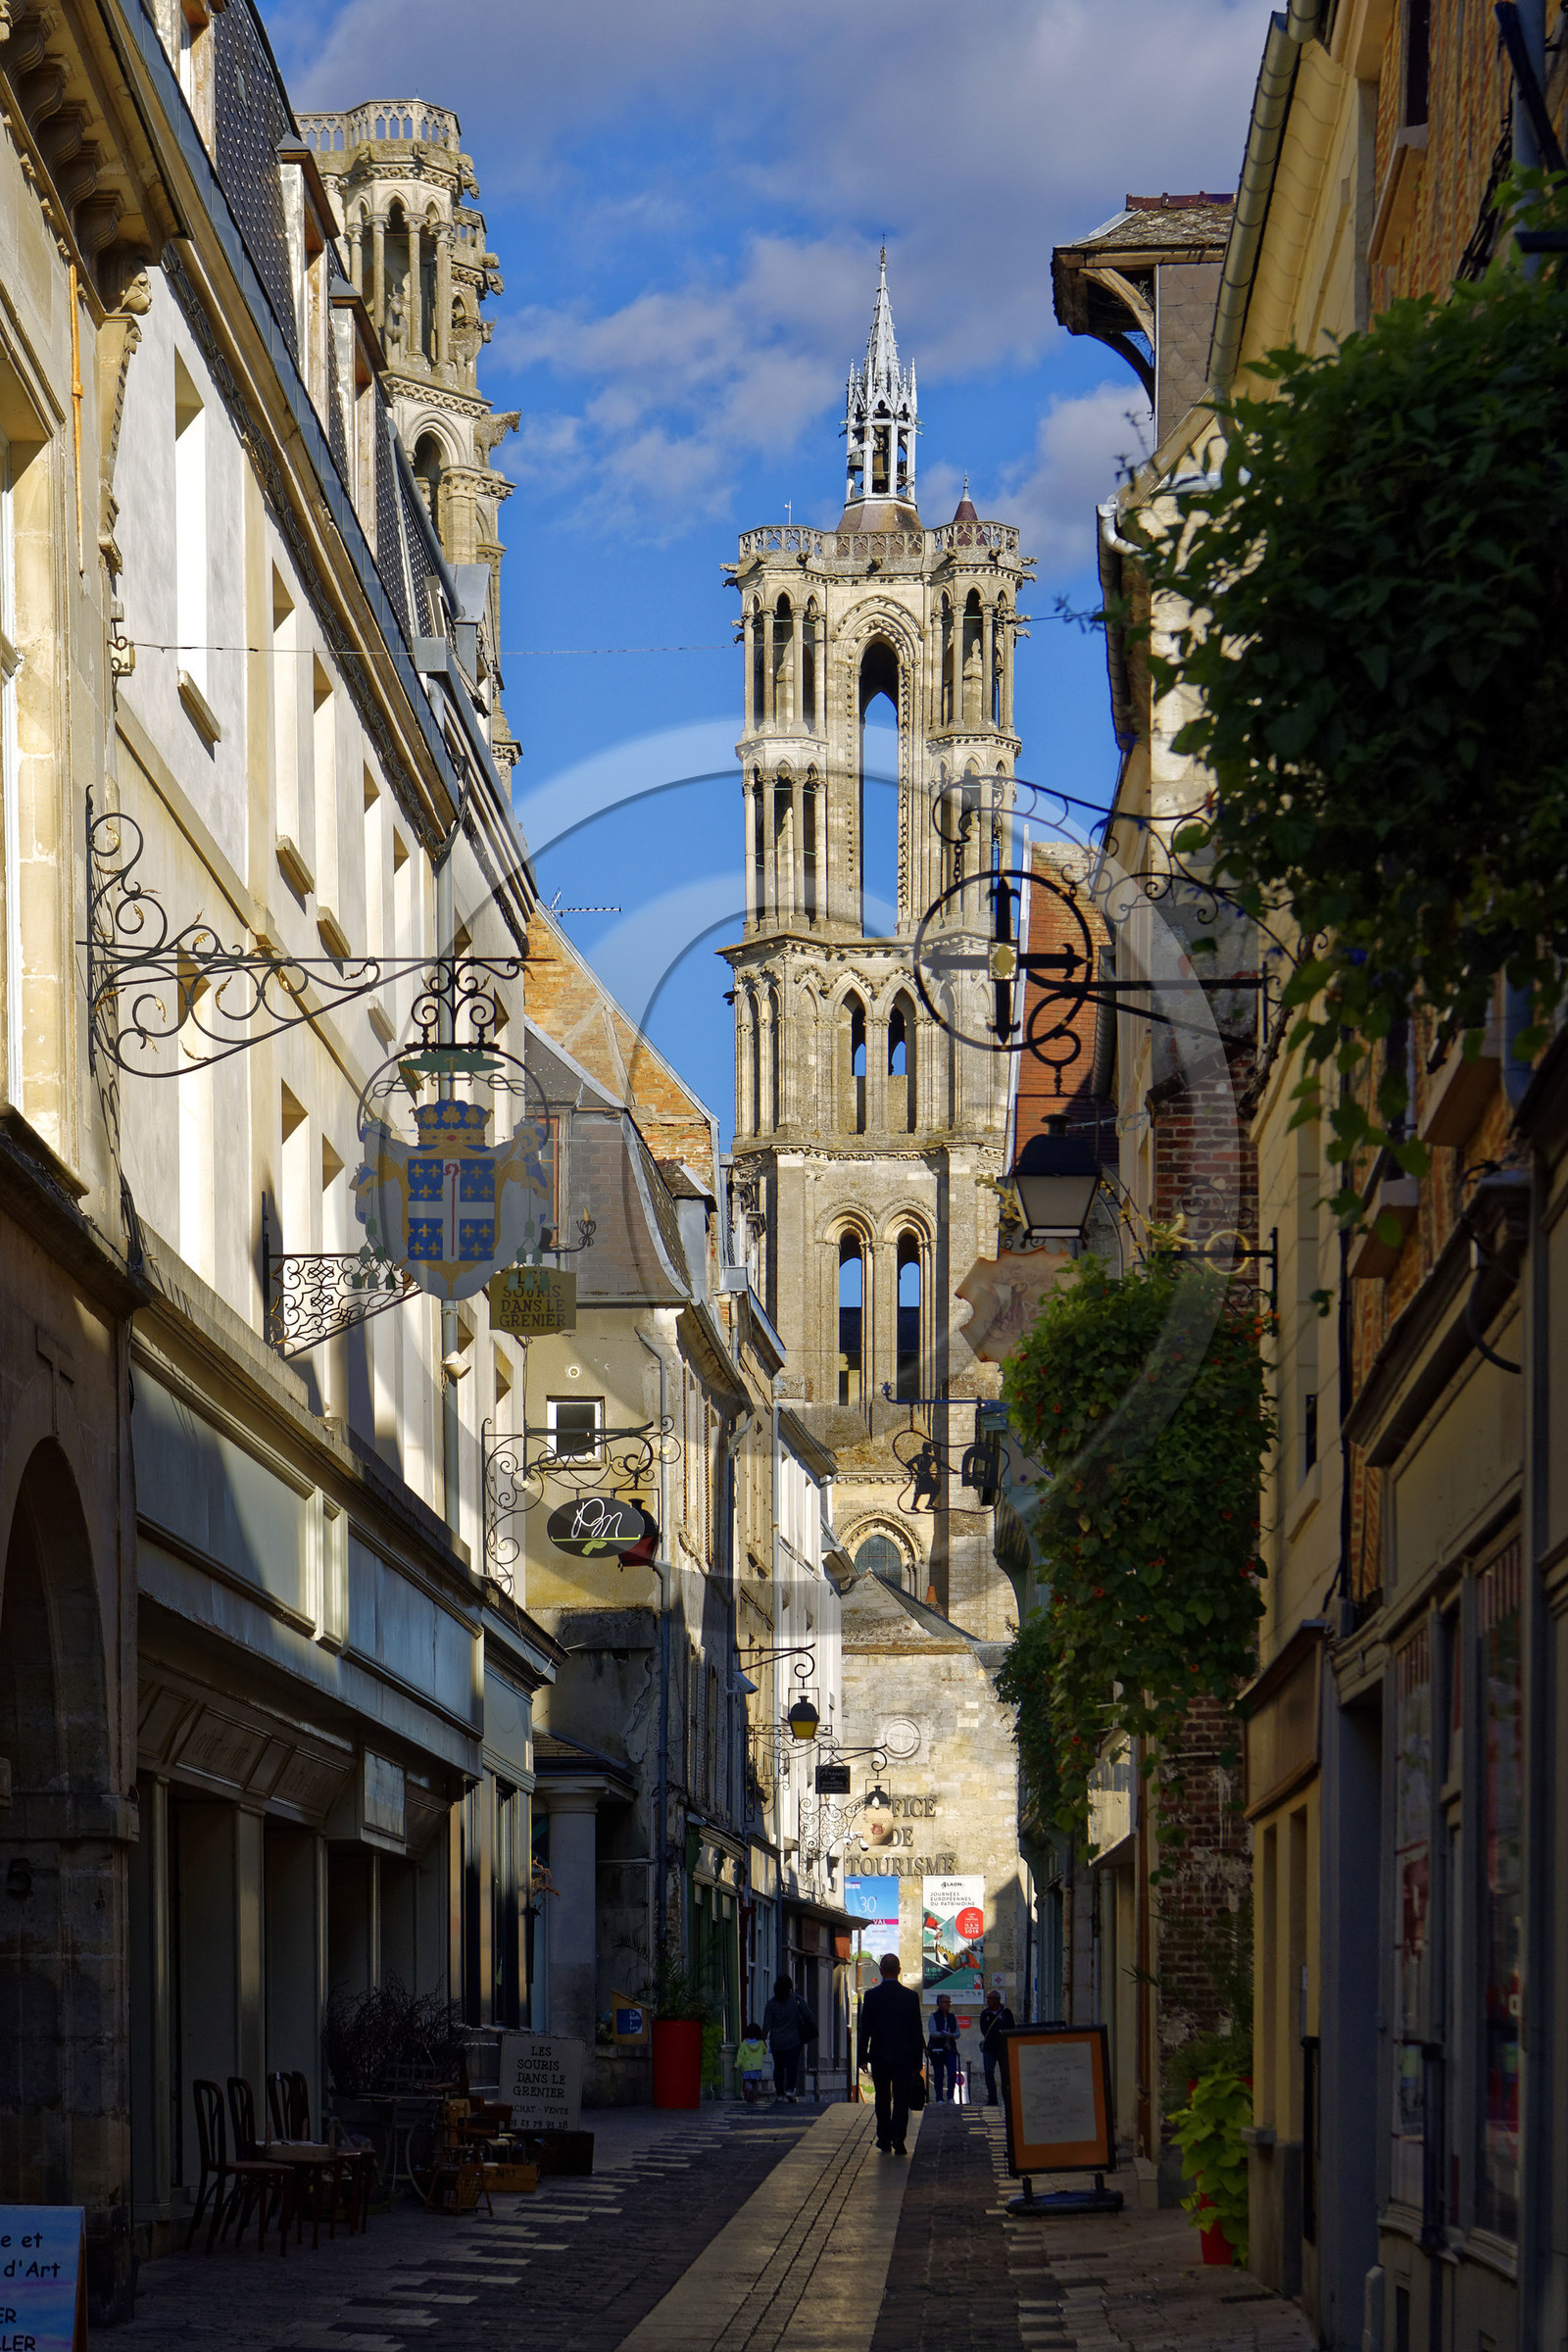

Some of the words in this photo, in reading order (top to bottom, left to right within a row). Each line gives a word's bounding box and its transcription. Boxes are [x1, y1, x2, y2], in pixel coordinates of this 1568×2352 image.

[501, 1299, 542, 1313] DANS
[546, 1299, 565, 1313] LE
[500, 1314, 565, 1328] GRENIER
[891, 1798, 937, 1818] FICE
[888, 1827, 914, 1847] DE
[846, 1857, 955, 1877] TOURISME
[531, 2046, 552, 2057] LES
[517, 2059, 560, 2071] SOURIS
[517, 2072, 548, 2084] DANS
[552, 2075, 566, 2085] LE
[513, 2086, 565, 2099] GRENIER
[544, 2106, 569, 2115] VENTE
[520, 2119, 529, 2128] 23
[532, 2120, 543, 2129] 79
[558, 2120, 568, 2130] 18
[22, 2231, 43, 2248] et
[4, 2259, 61, 2278] d'Art
[0, 2335, 35, 2352] LER
